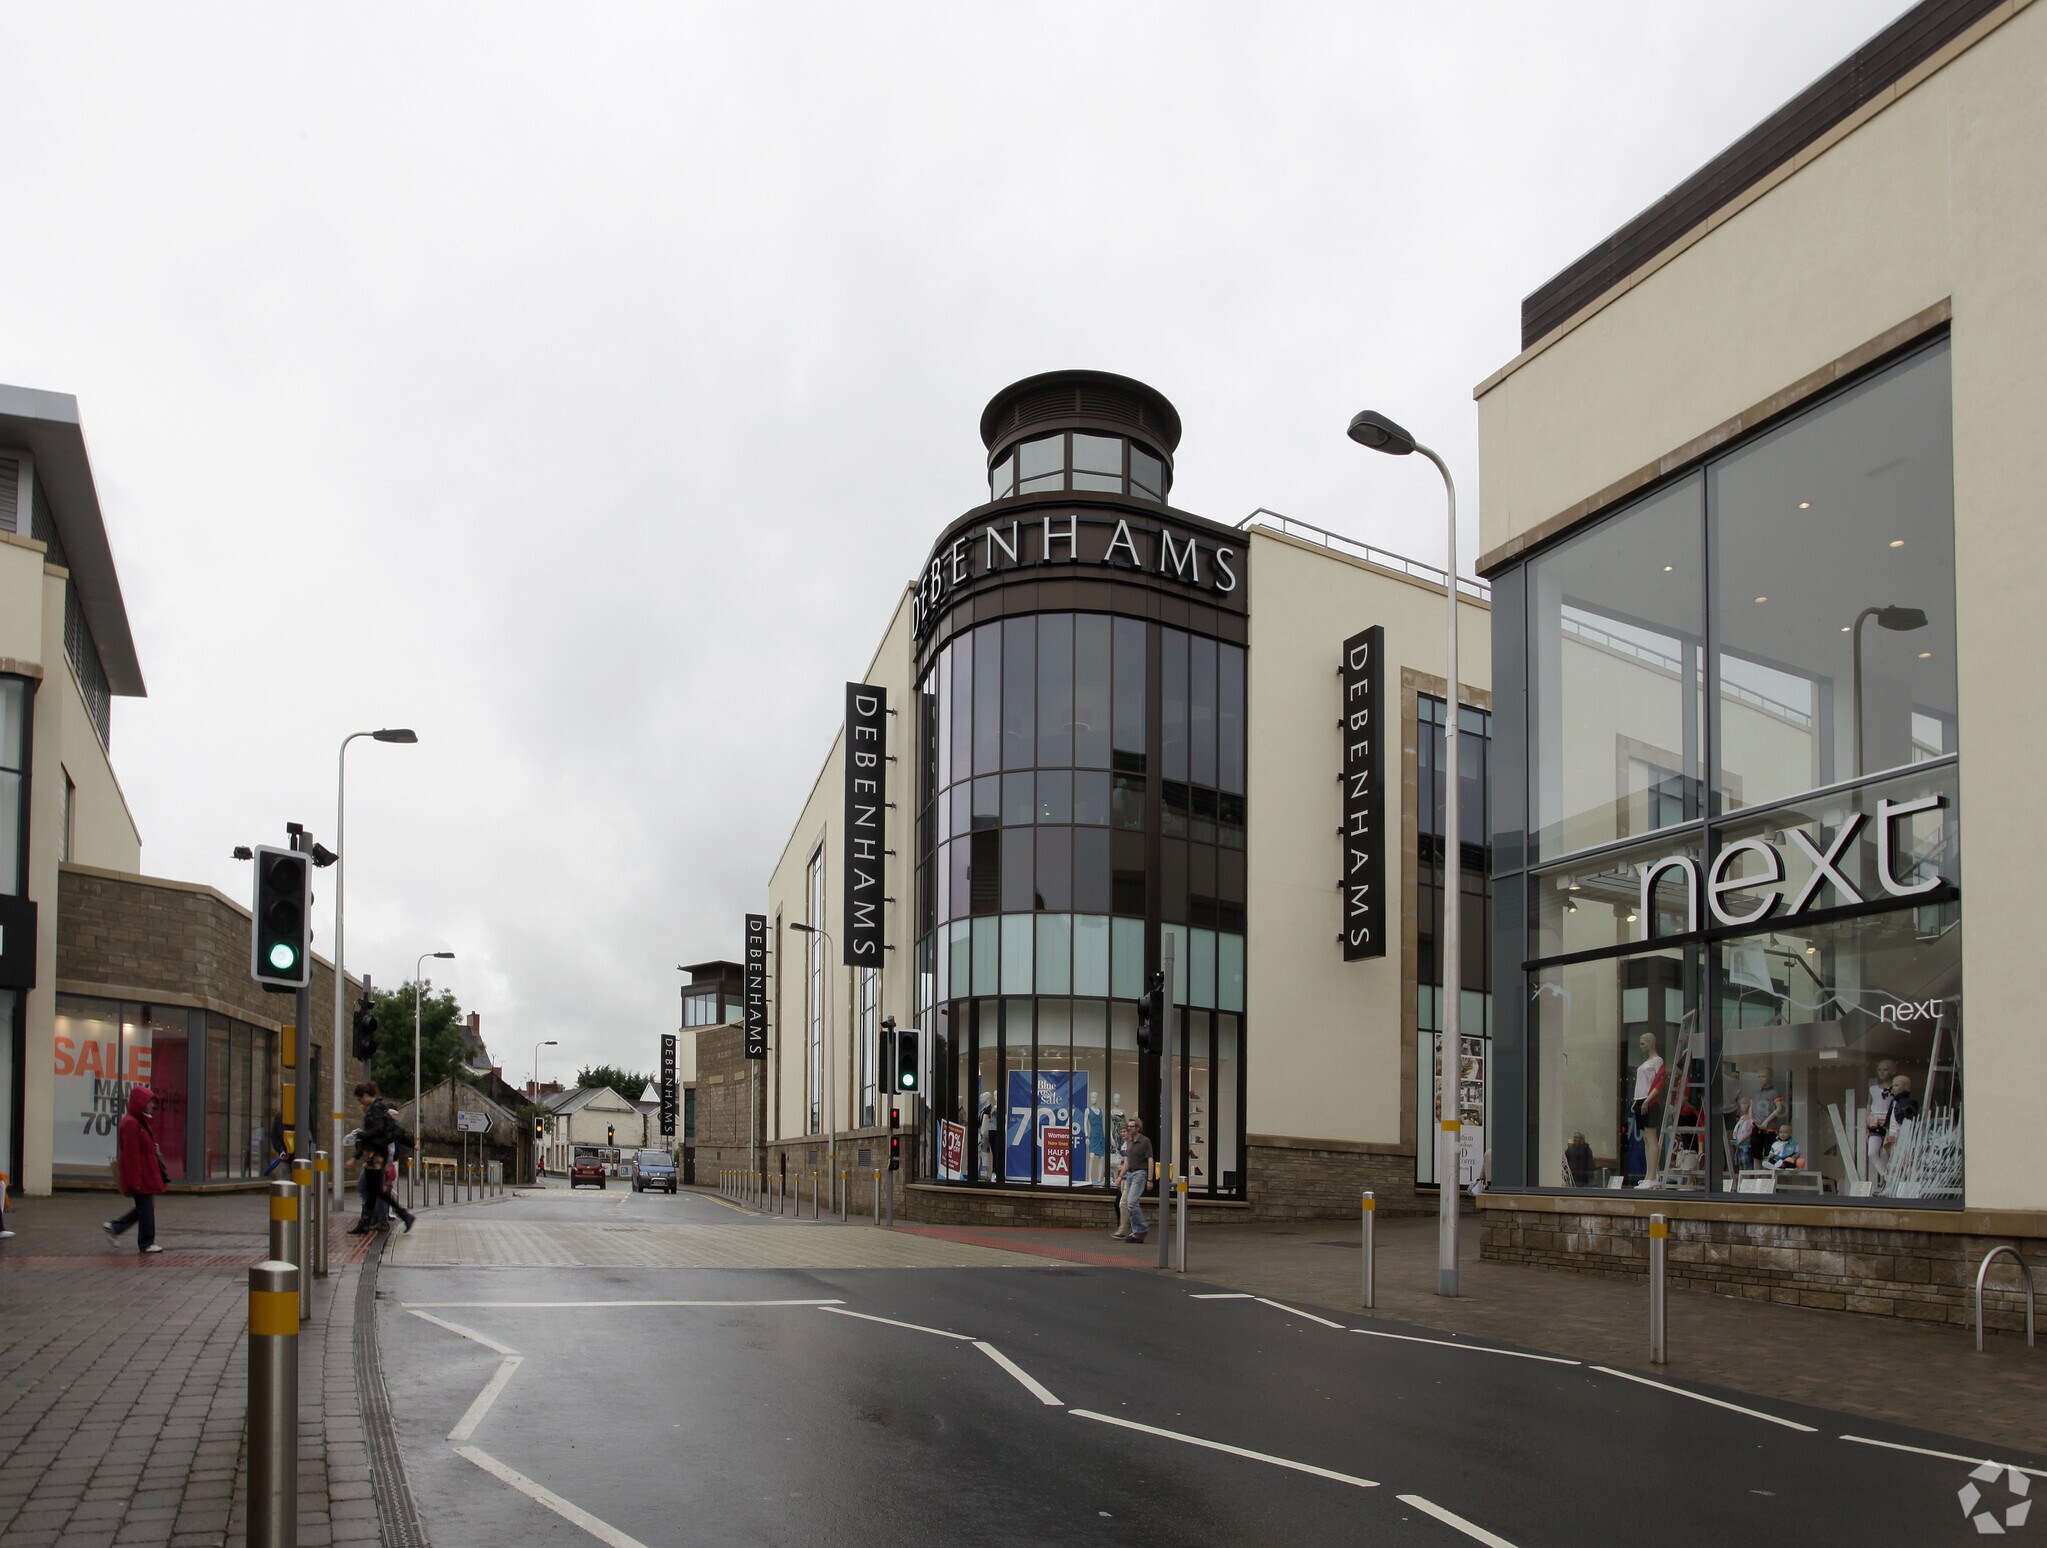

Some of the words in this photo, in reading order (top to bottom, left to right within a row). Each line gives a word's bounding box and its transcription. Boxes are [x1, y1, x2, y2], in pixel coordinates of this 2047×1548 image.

[912, 515, 1237, 642] DEBENHAMS
[853, 695, 877, 955] DEBENHAMS
[1349, 643, 1370, 947] DEBENHAMS
[1640, 795, 1949, 940] next
[750, 920, 762, 1054] DEBENHAMS
[1880, 998, 1944, 1023] next
[54, 1036, 152, 1083] SALE
[664, 1038, 673, 1132] DEBENHAMS
[1037, 1080, 1057, 1090] Blue
